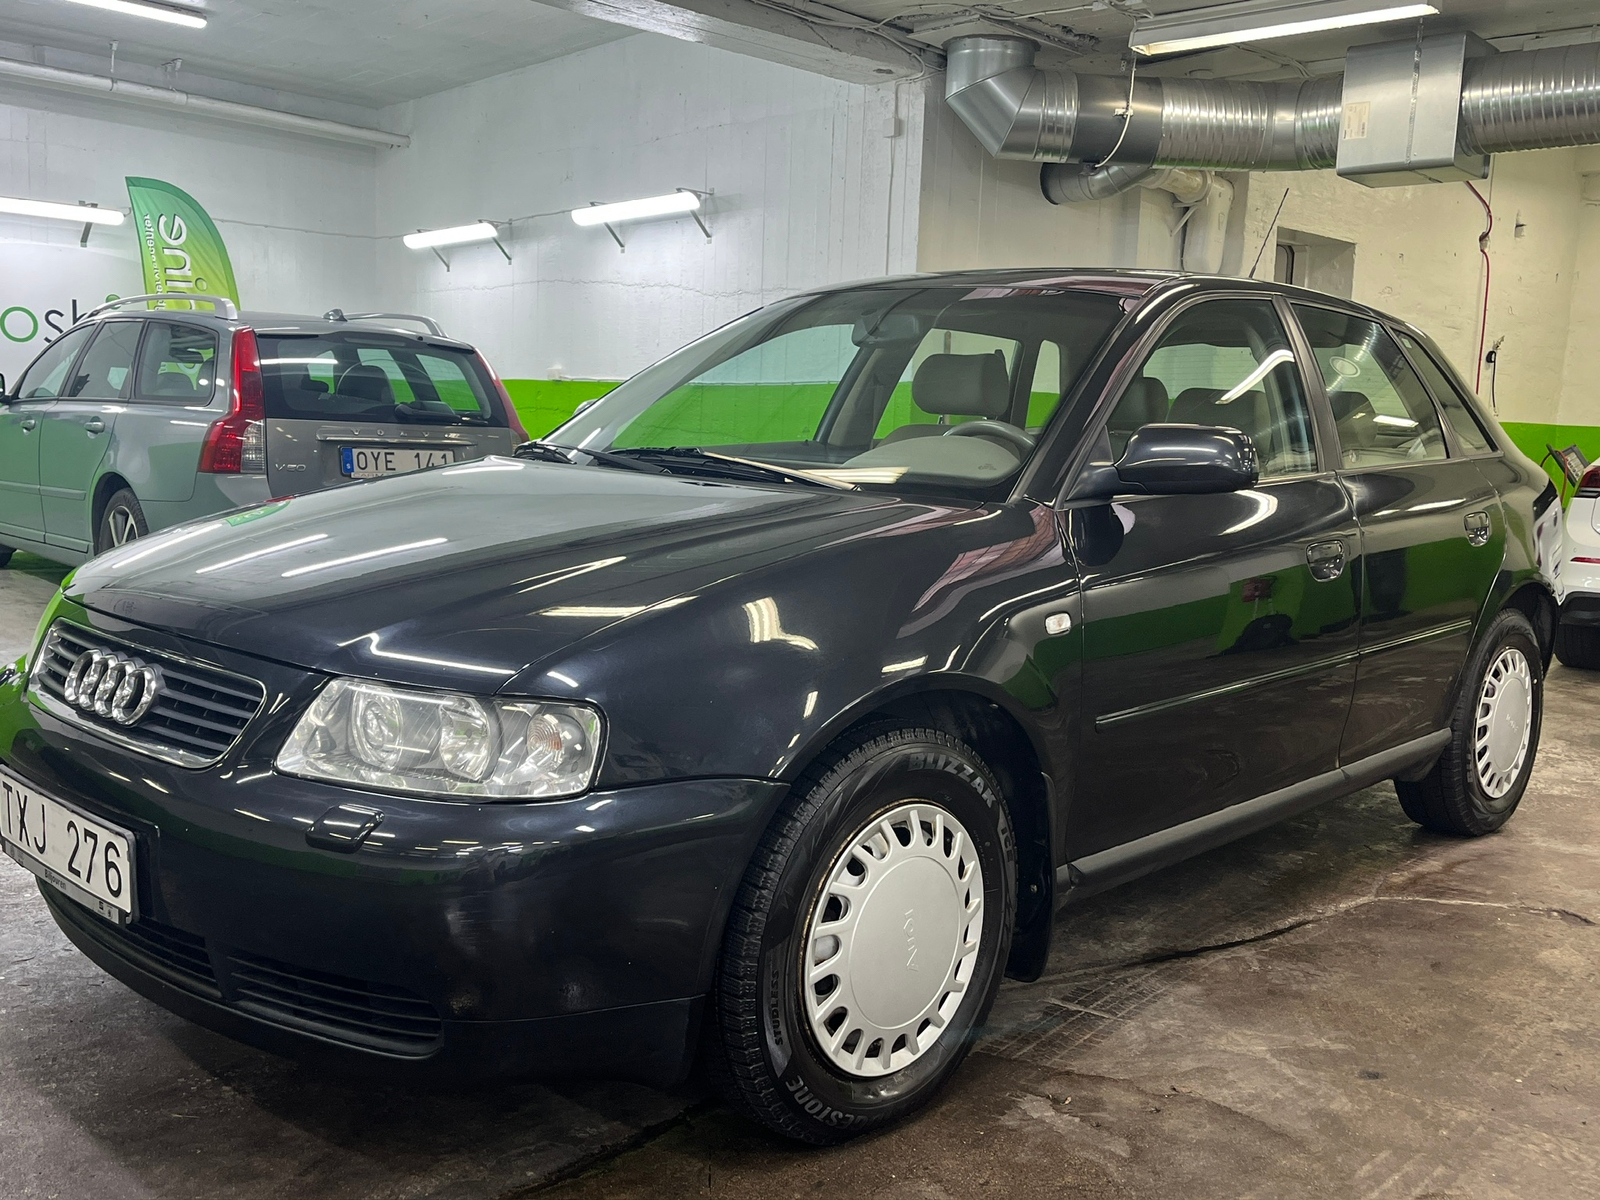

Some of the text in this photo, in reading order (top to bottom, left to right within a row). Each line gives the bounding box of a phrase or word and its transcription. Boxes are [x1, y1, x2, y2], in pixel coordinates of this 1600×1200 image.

[274, 462, 307, 472] V50
[356, 451, 448, 471] OYE 141
[907, 752, 997, 809] BLIZZAK
[2, 780, 122, 898] TXJ 276
[773, 969, 784, 1046] STUDLESS
